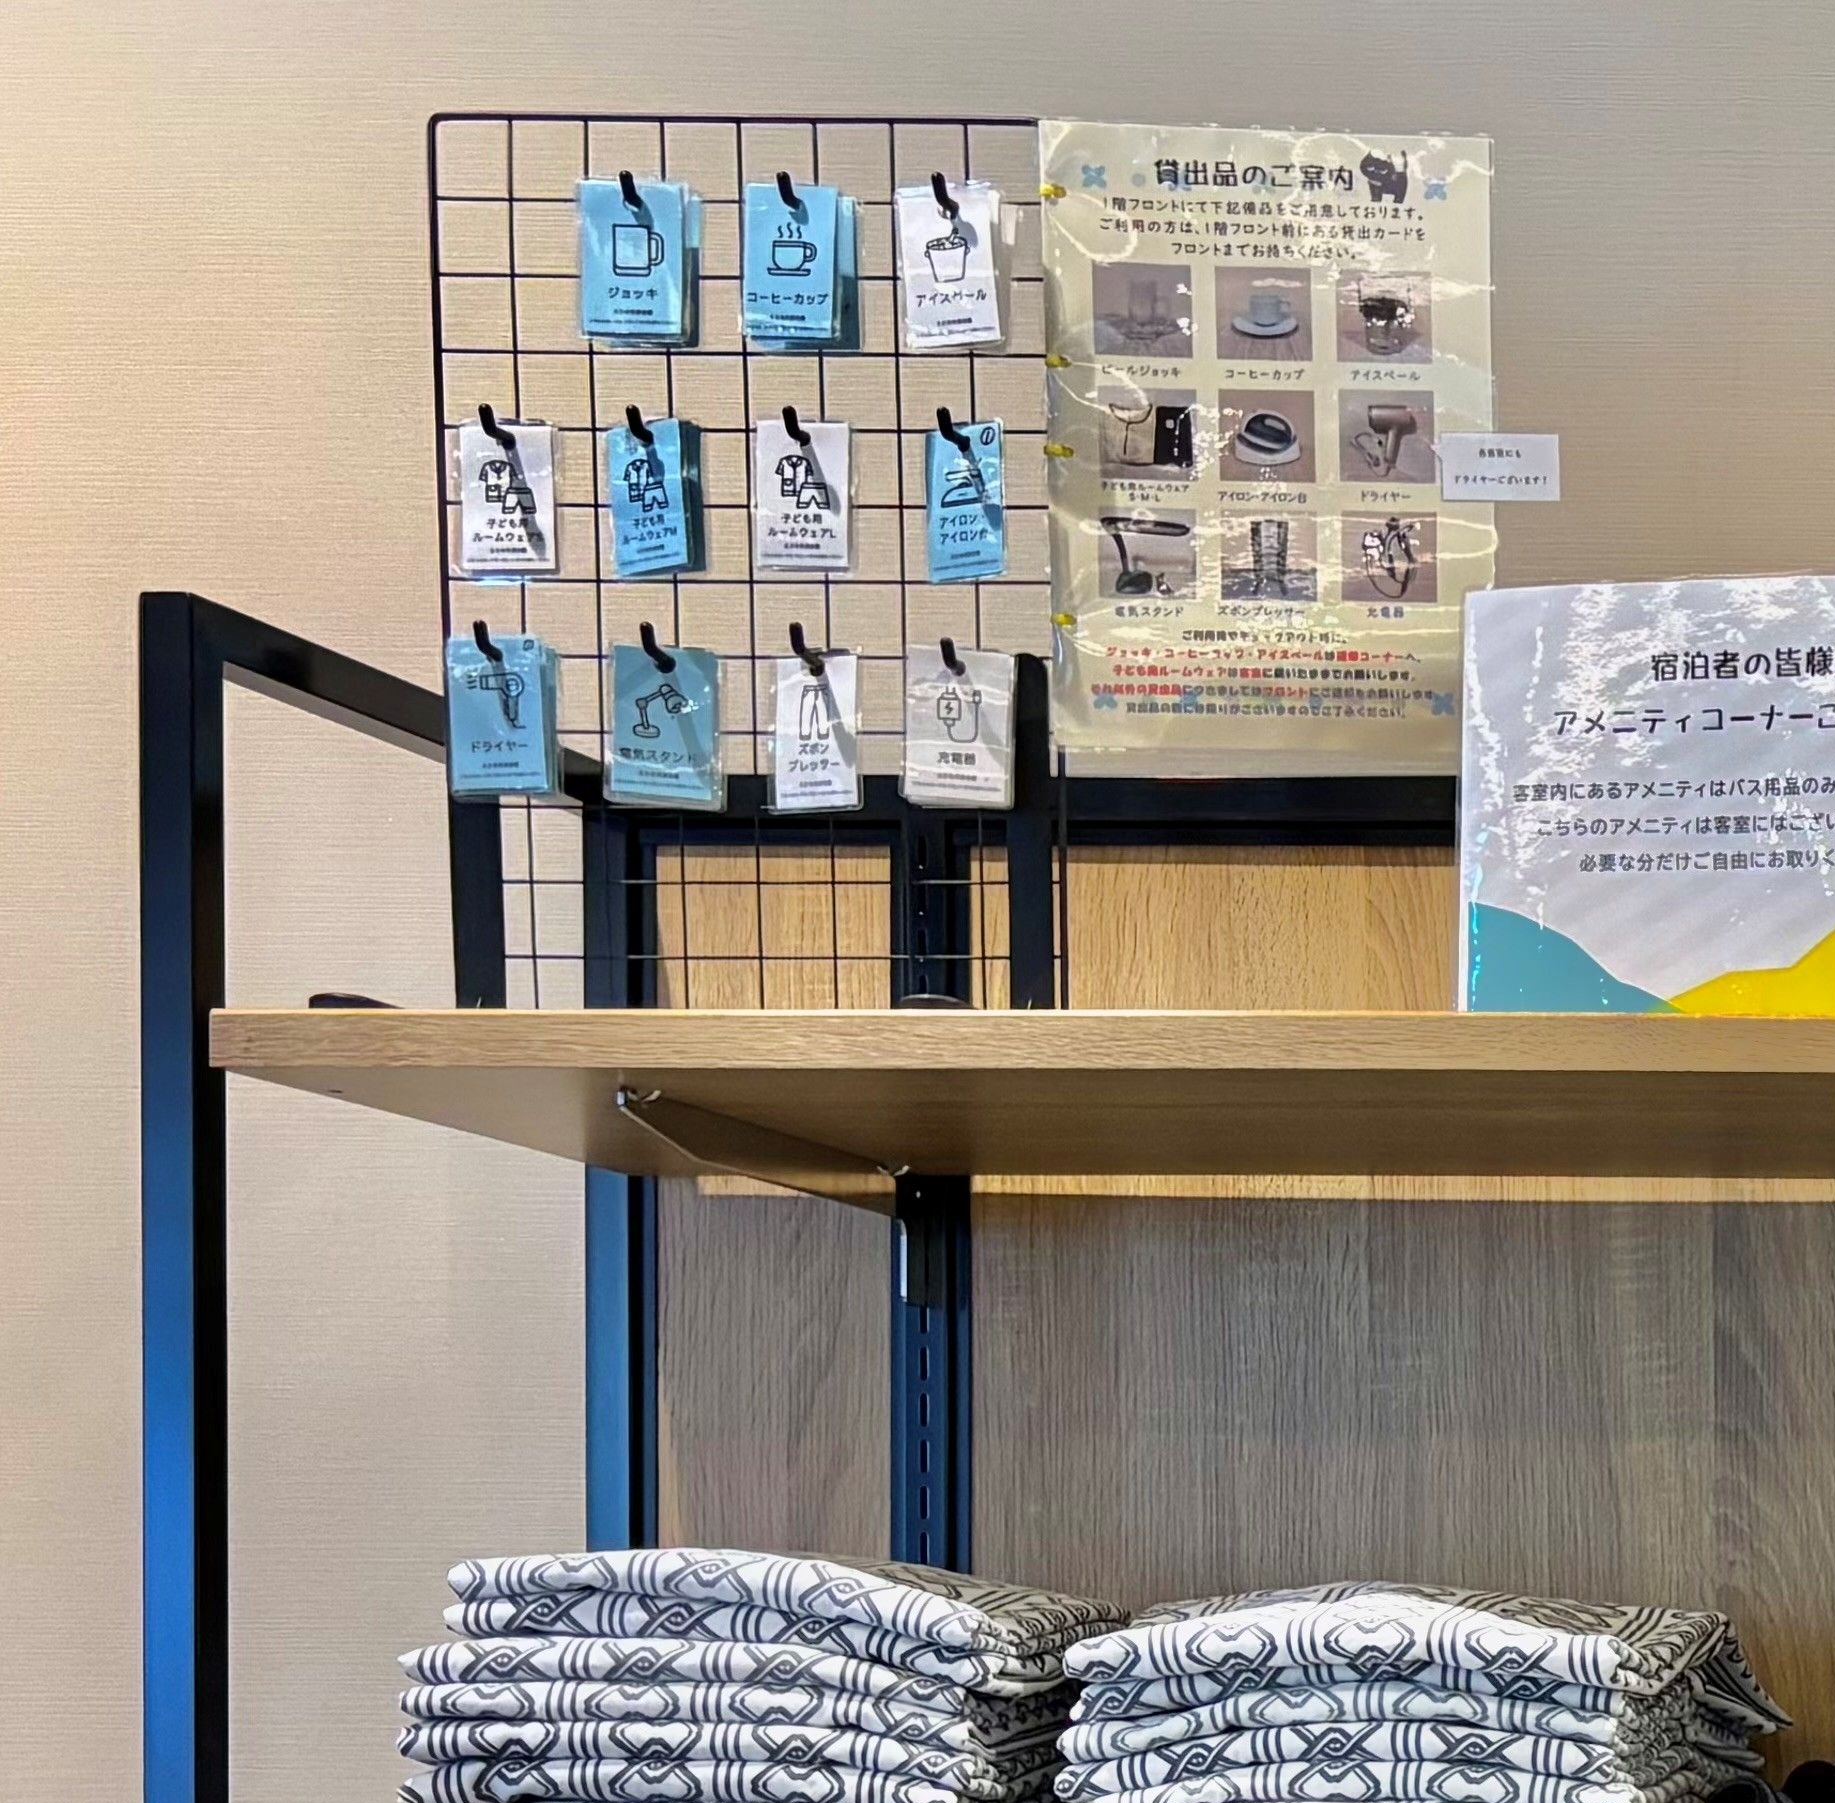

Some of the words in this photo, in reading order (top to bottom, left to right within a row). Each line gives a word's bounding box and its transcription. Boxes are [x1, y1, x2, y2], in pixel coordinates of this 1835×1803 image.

[1153, 158, 1354, 191] 貸出品のご案内
[607, 286, 658, 300] ジョッキ
[746, 291, 829, 306] コーヒーカップ
[1225, 368, 1304, 380] コーヒーカップ
[1351, 368, 1421, 381] アイスペール
[1360, 490, 1412, 502] ドライヤー
[471, 740, 529, 753] ドライヤー
